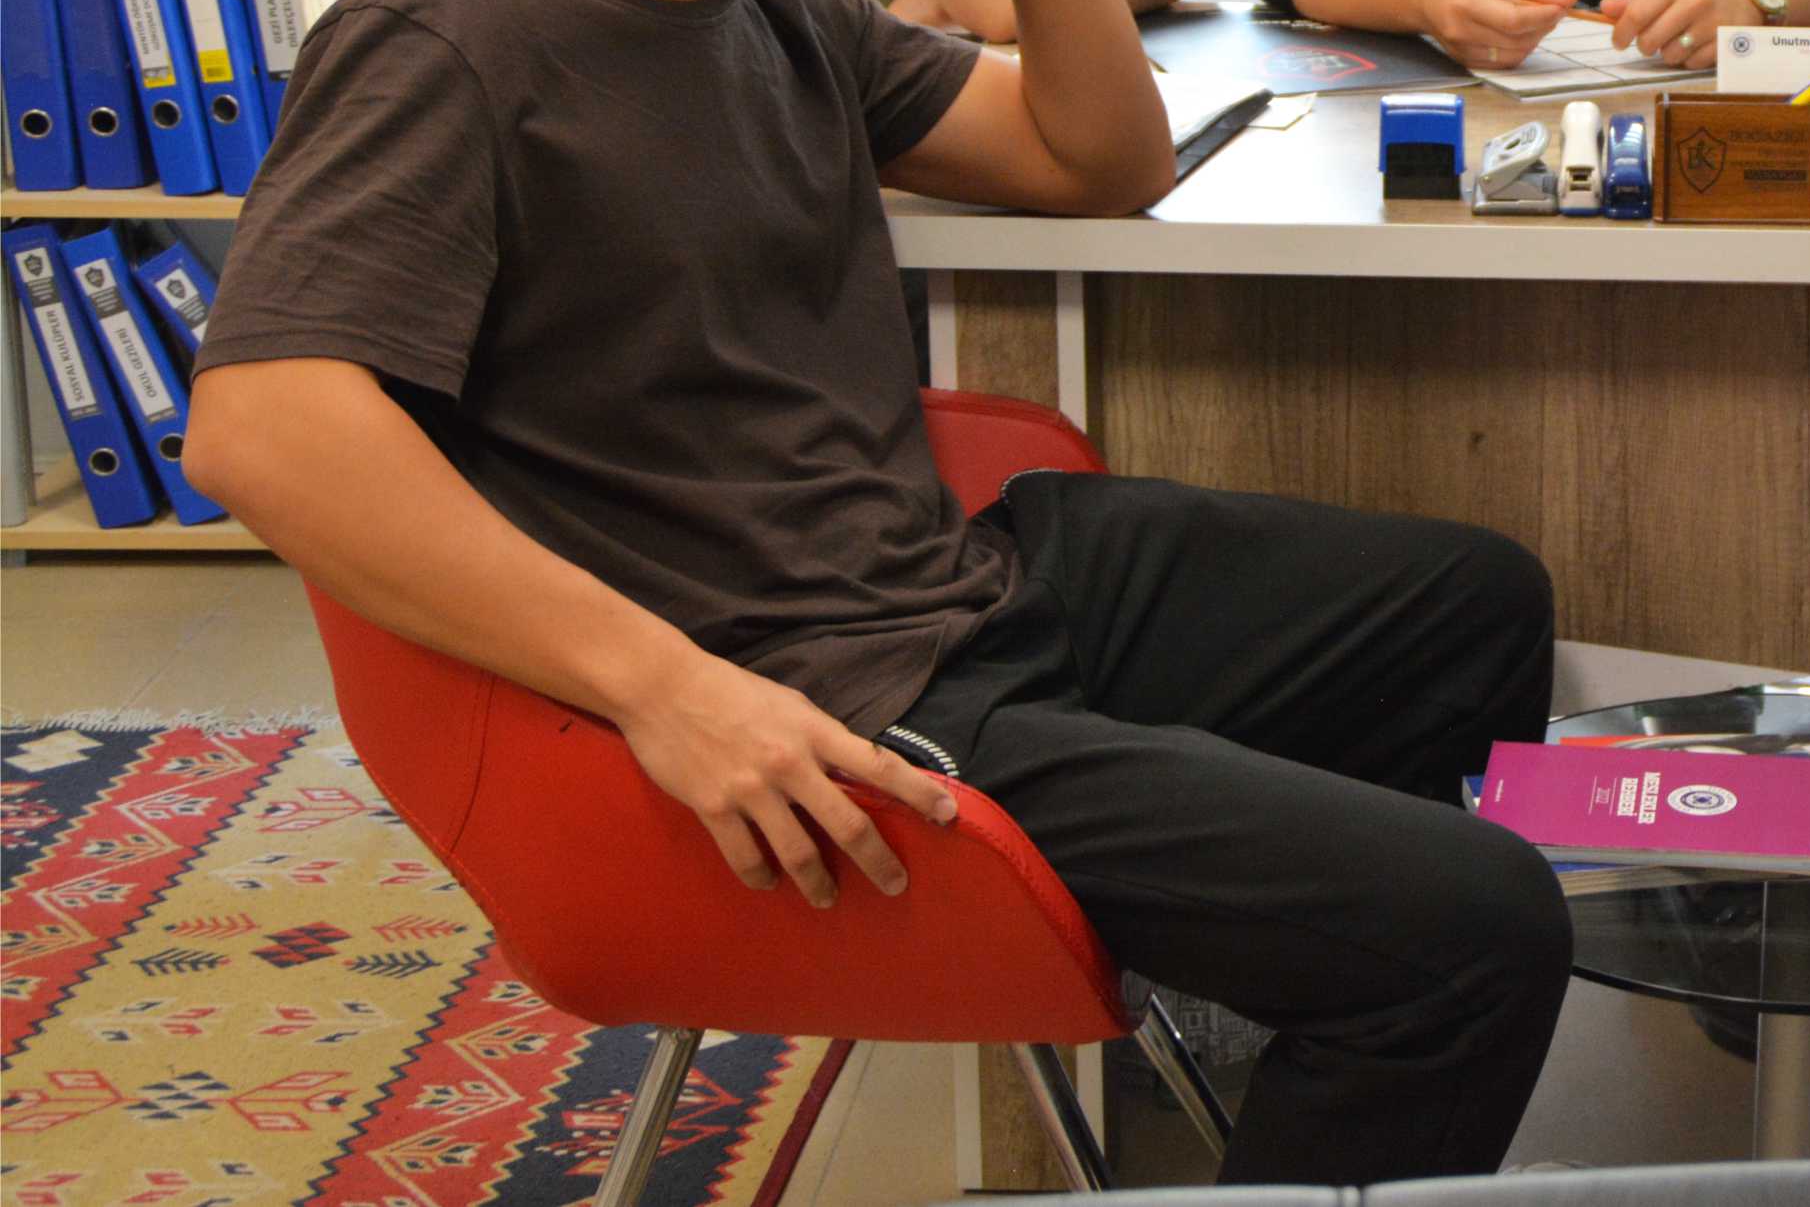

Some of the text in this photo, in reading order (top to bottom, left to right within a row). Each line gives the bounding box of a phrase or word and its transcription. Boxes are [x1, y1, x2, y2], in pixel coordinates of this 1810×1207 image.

[266, 23, 281, 44] GEZİ
[46, 310, 85, 402] SOSYAL KULÜPLER
[138, 371, 157, 398] OKUL
